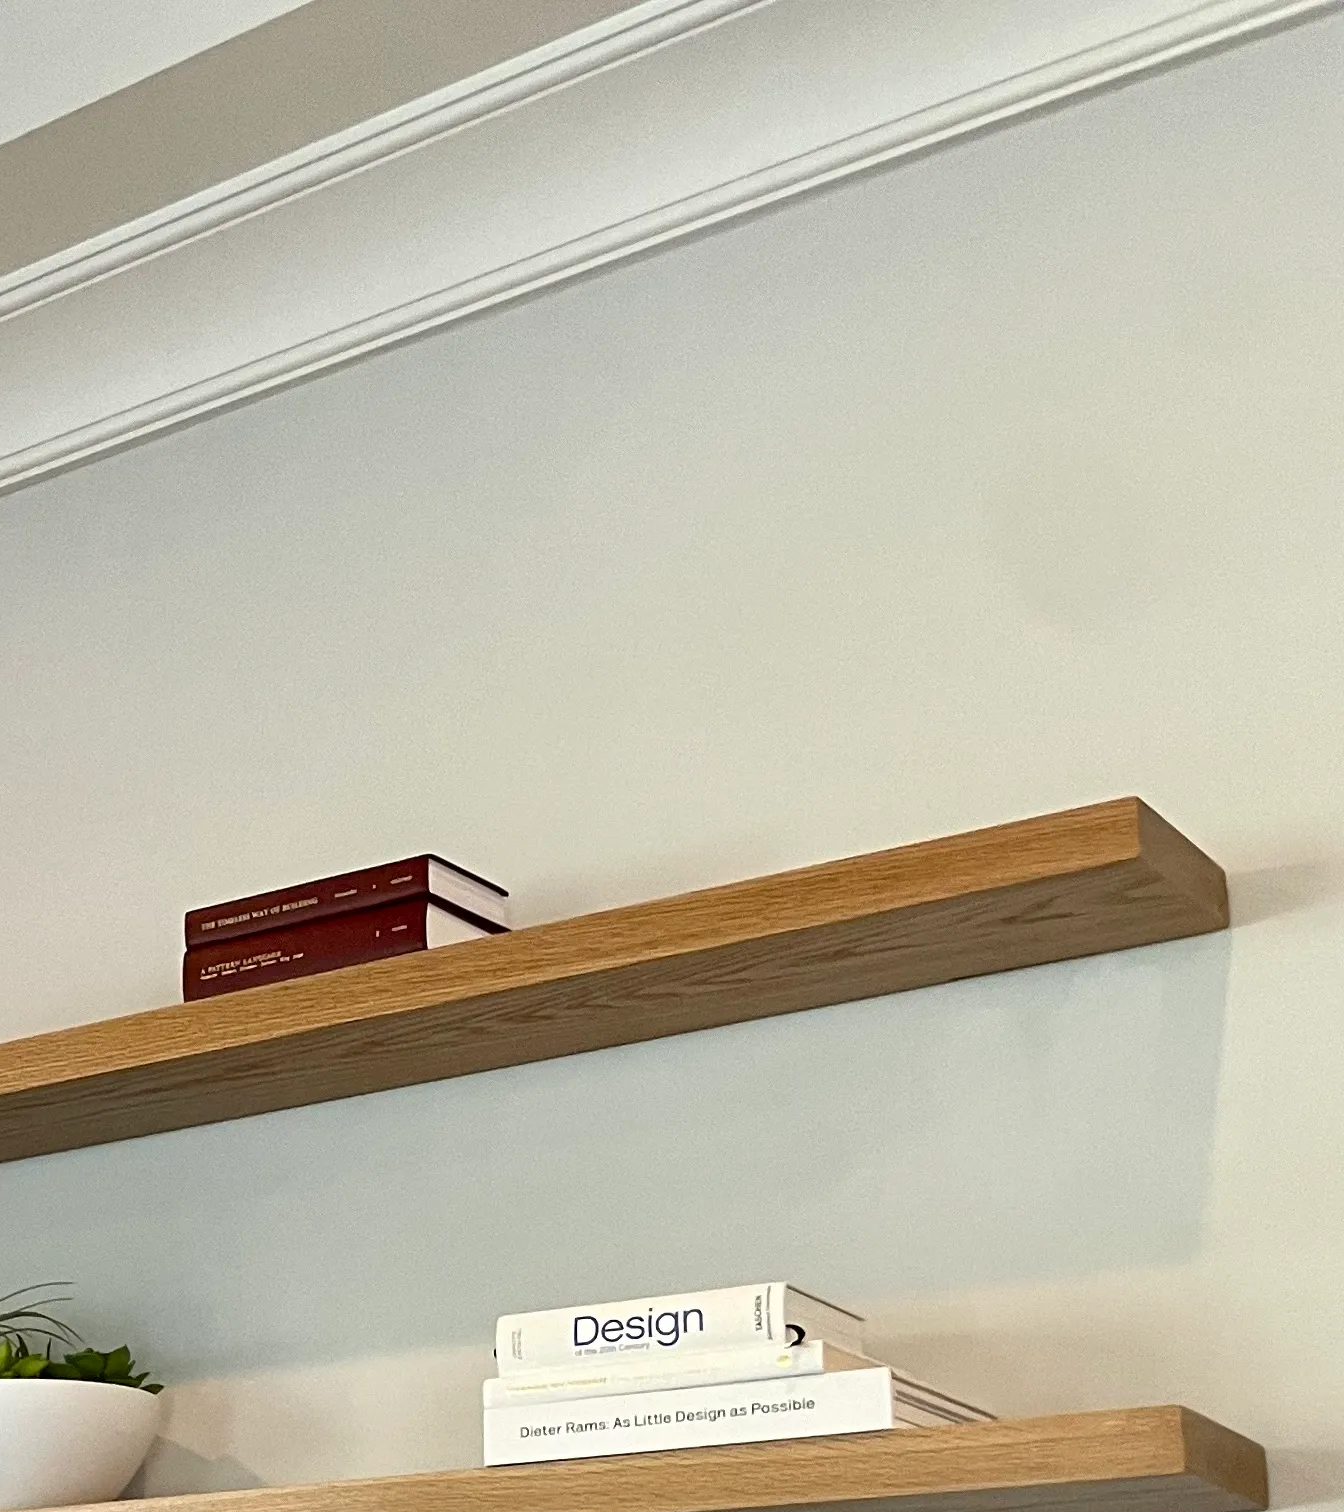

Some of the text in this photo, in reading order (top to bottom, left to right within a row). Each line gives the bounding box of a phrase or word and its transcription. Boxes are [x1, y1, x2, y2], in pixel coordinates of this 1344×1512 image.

[573, 1307, 704, 1347] Design
[753, 1295, 763, 1331] TASCHEN
[520, 1397, 815, 1438] Dieter Rams: As Little Design as Possible
